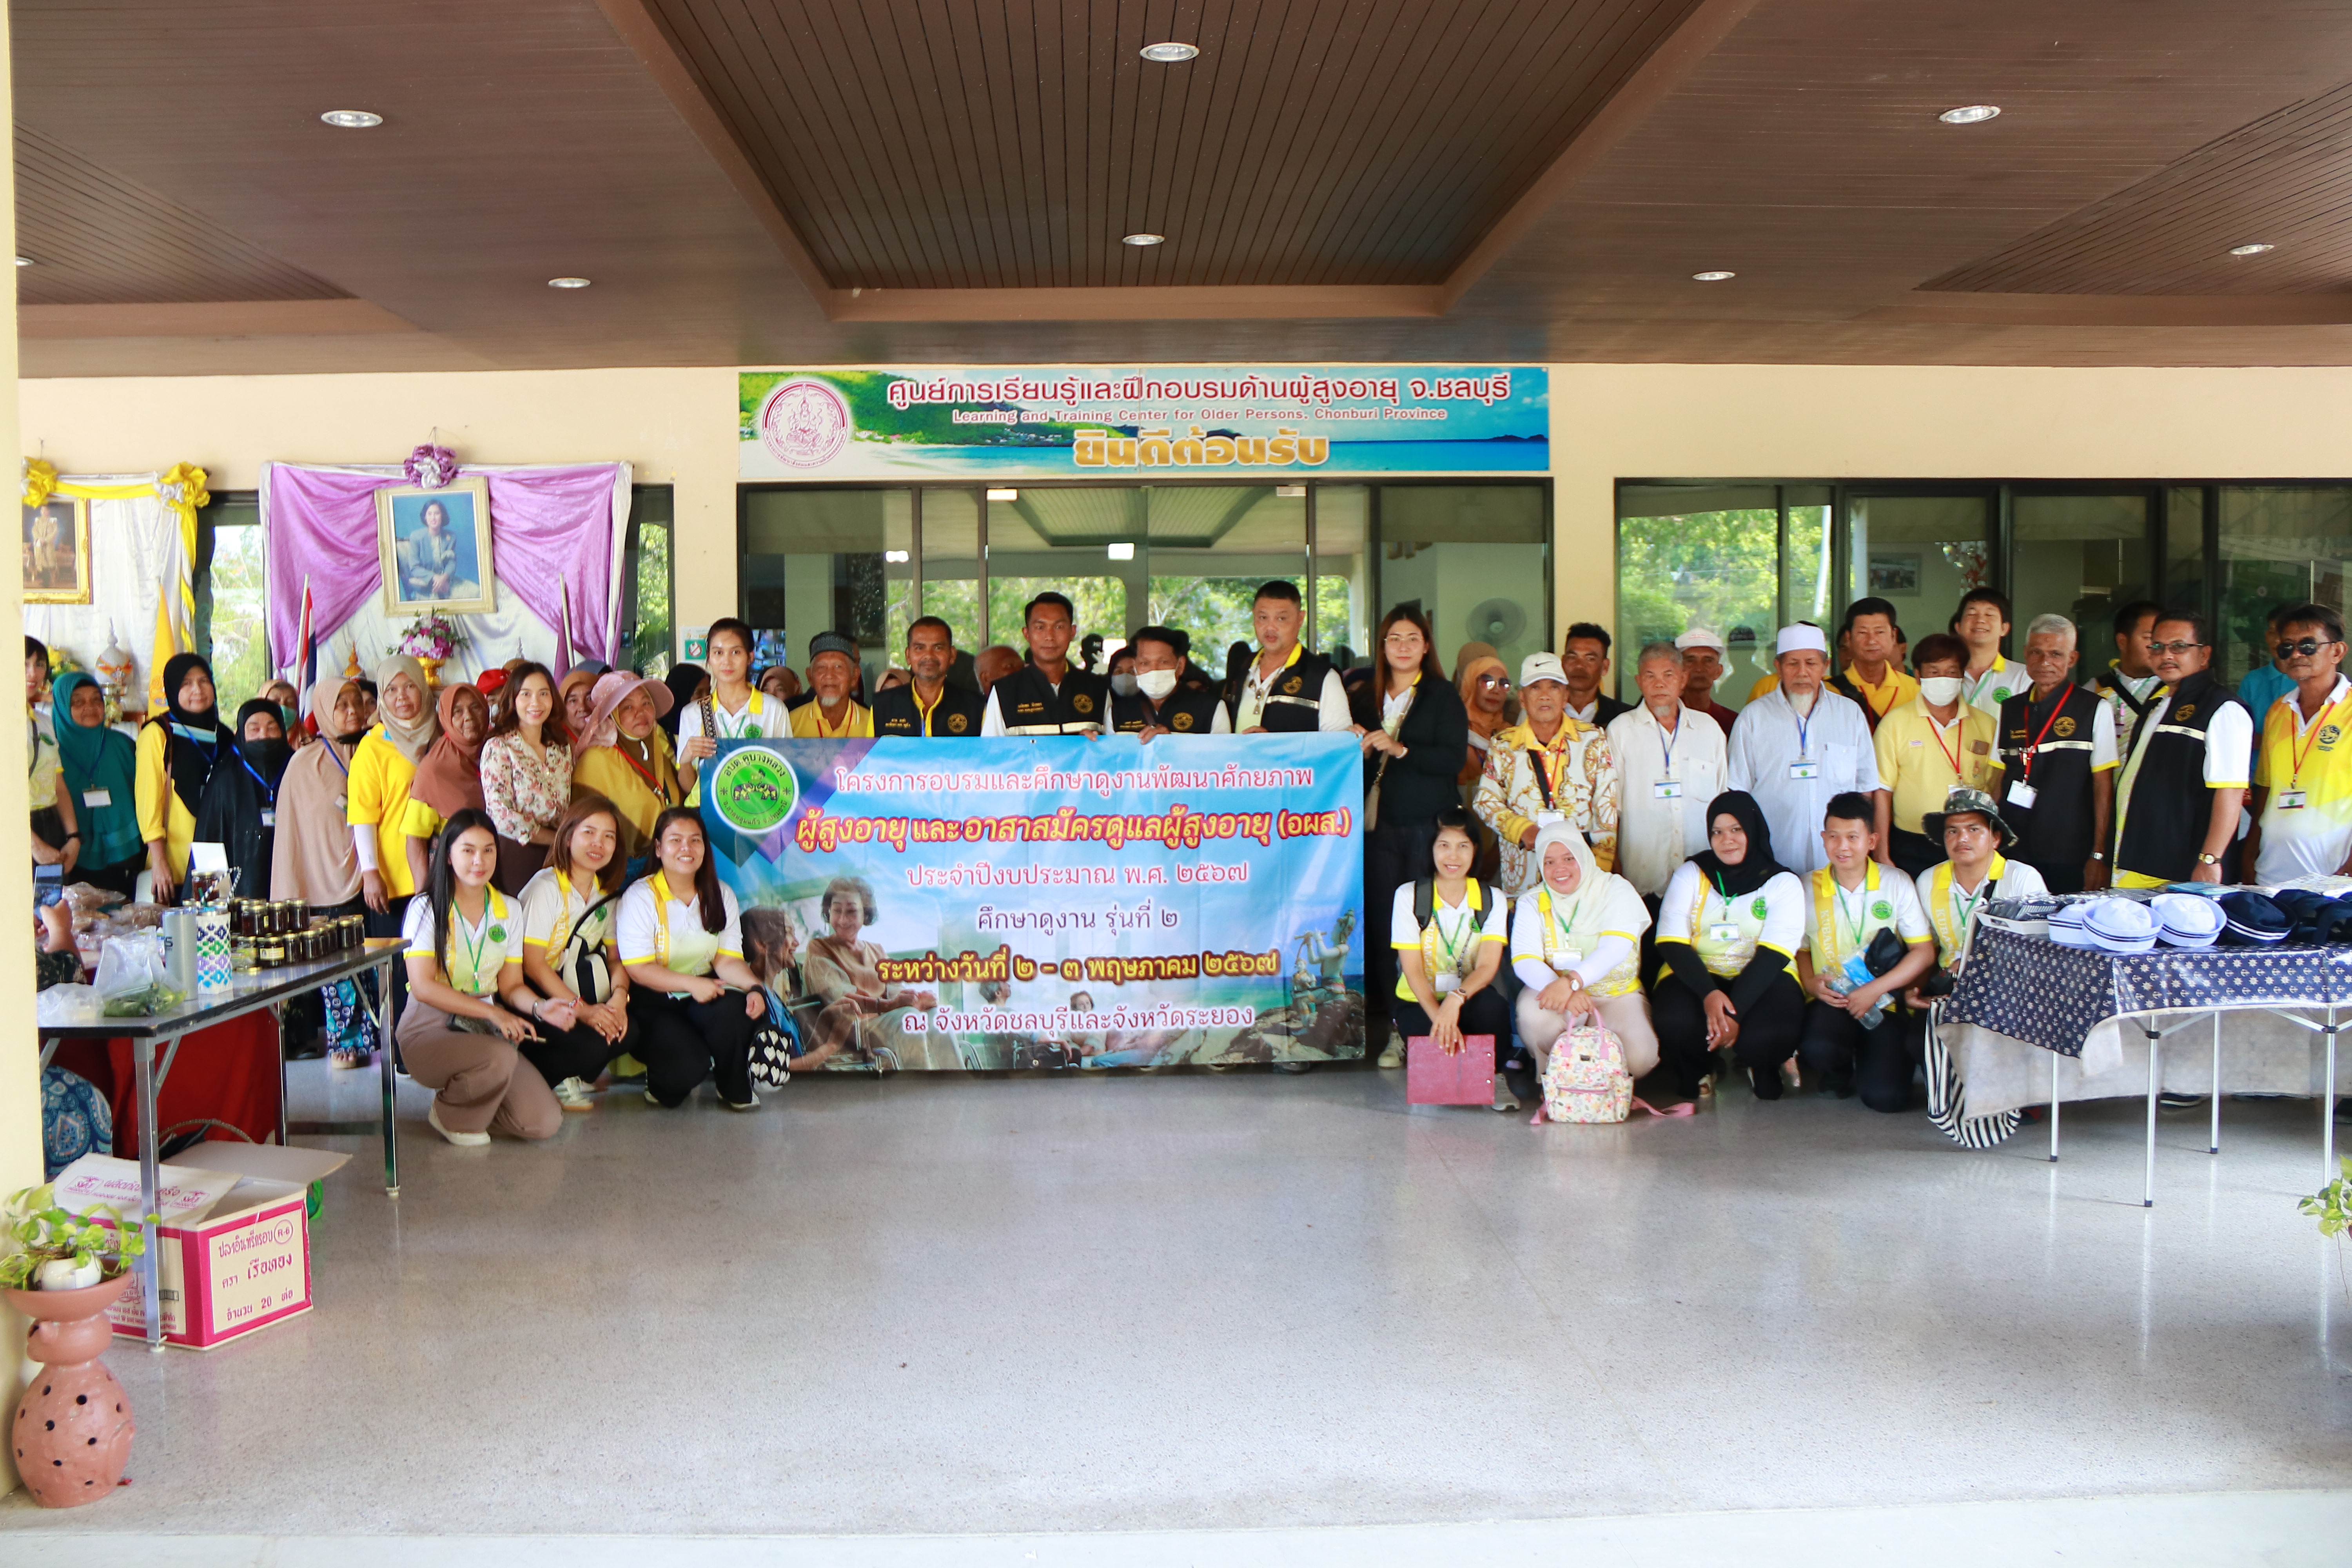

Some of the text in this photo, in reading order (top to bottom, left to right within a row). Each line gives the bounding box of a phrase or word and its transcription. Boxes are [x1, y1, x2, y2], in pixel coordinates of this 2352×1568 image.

[889, 374, 1508, 408] ศูนย์การเรียนรู้และฝึกอบรมด้านผู้สูงอายุ จ.ชลบุรี
[954, 408, 1446, 423] Learning and Training Center for Older Persons, Chonburi Province
[1074, 426, 1328, 466] ยินดีต้อนรับ
[835, 765, 1312, 797] โครงการอบรมและศึกษาดูงานพัฒนาศักยภาพ
[1278, 809, 1350, 837] (อผส.)
[907, 862, 1248, 886] ประจำปีงบประมาณ พ.ศ. ๒๕๖๗
[978, 899, 1178, 935] ศึกษาดูงาน รุ่นที่ ๒
[877, 946, 1007, 981] ระหว่างวันที่
[1015, 957, 1034, 977] ๒
[1063, 962, 1079, 977] ๓
[1087, 958, 1197, 983] พฤษภาคม
[1204, 951, 1277, 974] ๒๕๖๗
[905, 1006, 1253, 1039] ณ จังหวัดชลบุรีและจังหวัดระยอง
[247, 1253, 292, 1279] เรือทอง
[227, 1286, 294, 1321] จำนวน 20 ห่อ
